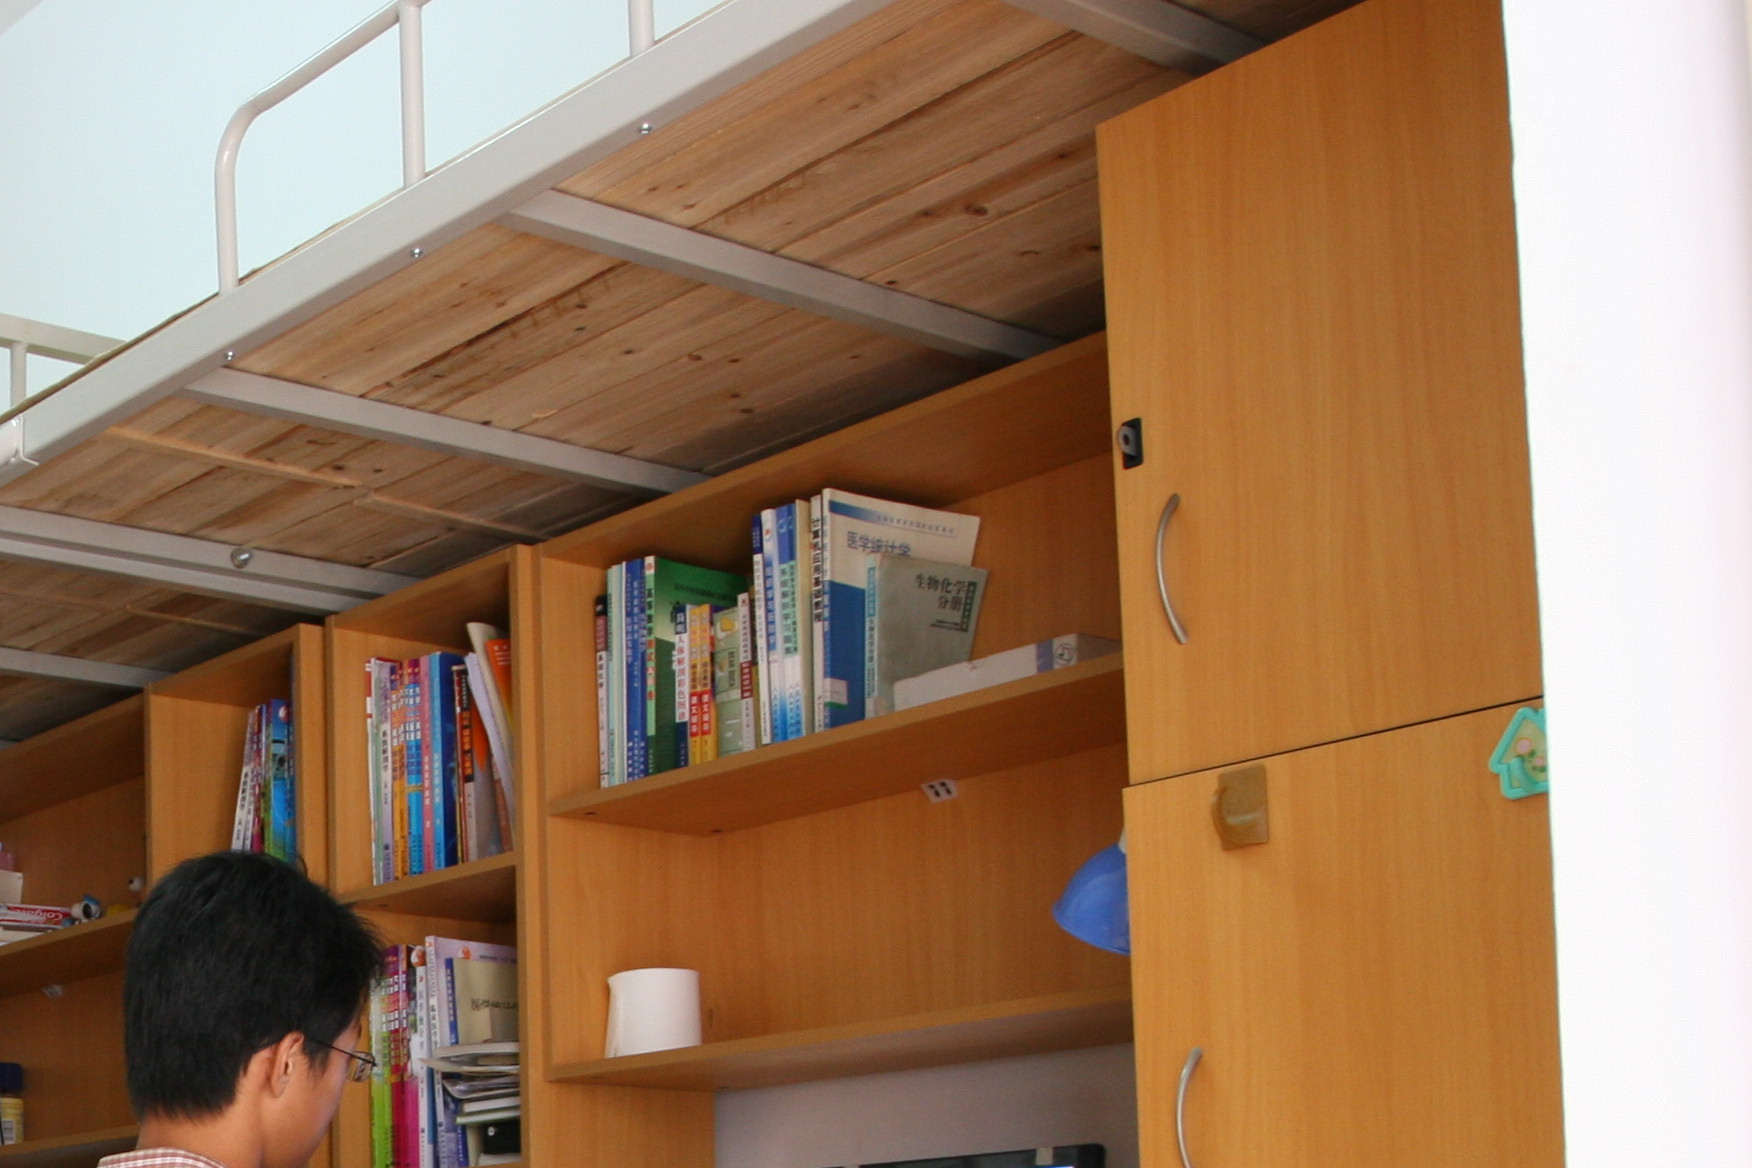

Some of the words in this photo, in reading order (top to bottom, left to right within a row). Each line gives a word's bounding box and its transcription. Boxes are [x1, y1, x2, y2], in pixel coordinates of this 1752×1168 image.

[847, 530, 911, 556] 医学统计学
[915, 573, 967, 594] 生物化学
[14, 908, 64, 921] Colgate
